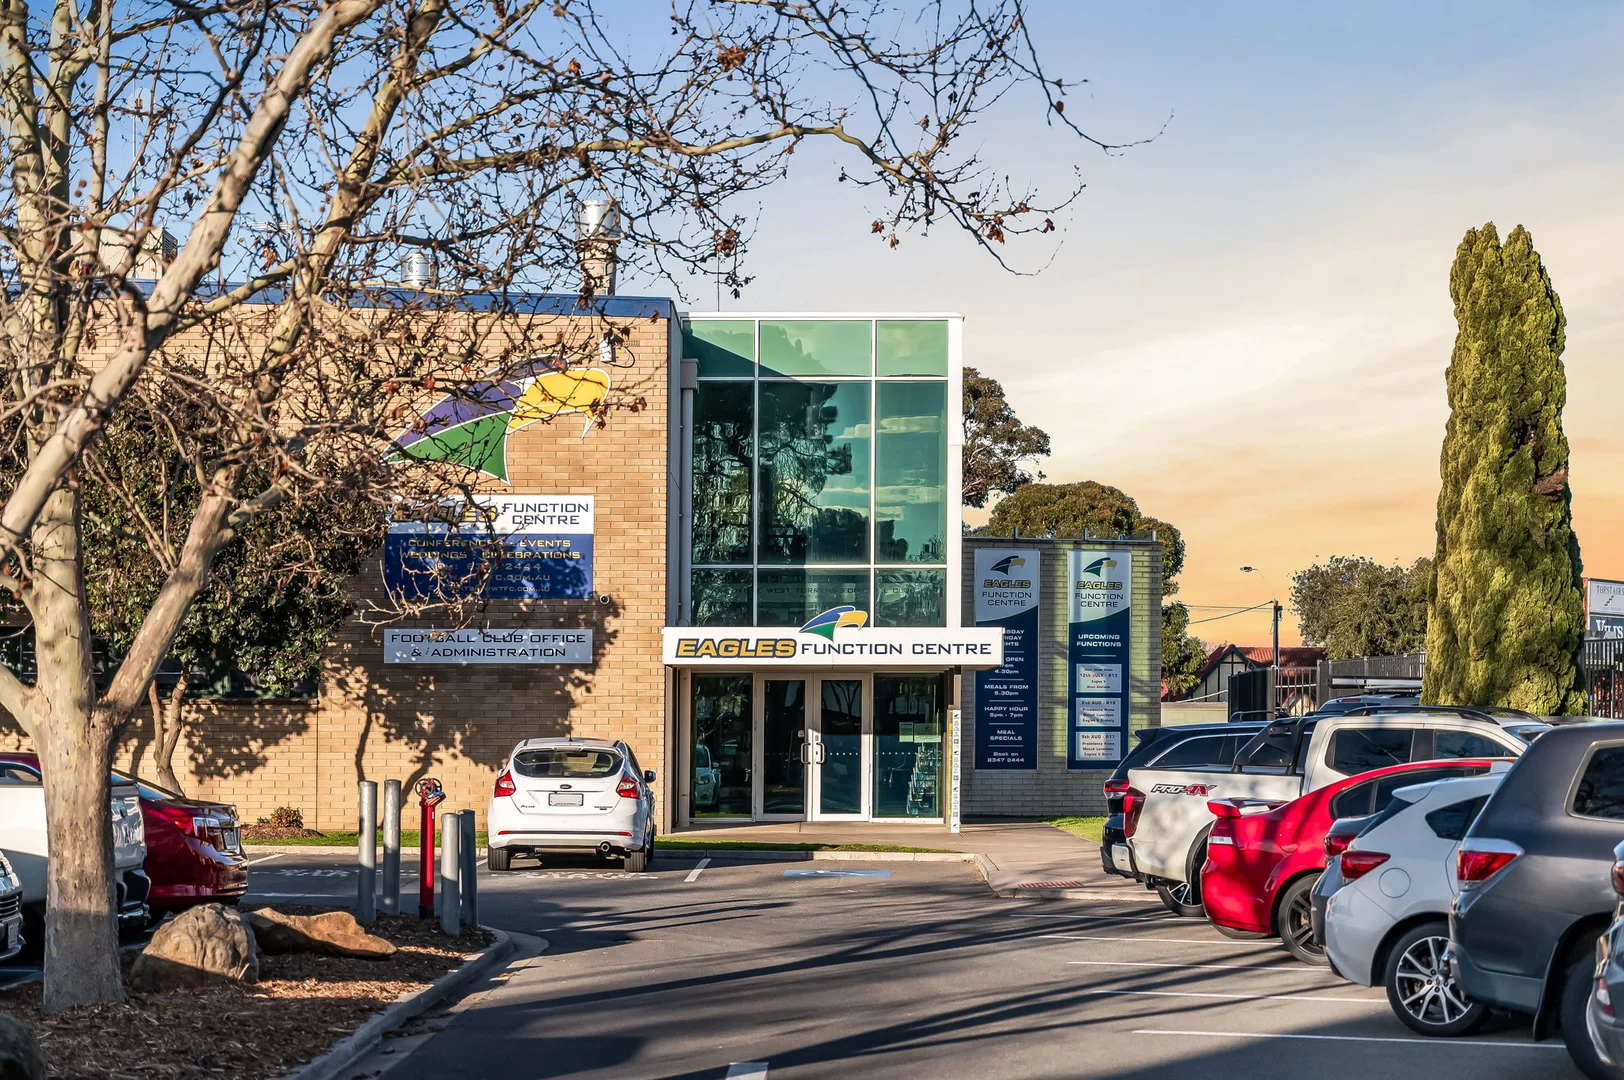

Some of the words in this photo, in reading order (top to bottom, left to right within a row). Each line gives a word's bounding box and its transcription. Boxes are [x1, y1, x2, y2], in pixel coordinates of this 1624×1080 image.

[503, 503, 588, 512] FUNCTION
[512, 515, 580, 524] CENTRE
[520, 539, 571, 547] EVENTS
[482, 551, 580, 559] CEEBRATIONS
[983, 579, 1031, 588] EAGLES
[1076, 581, 1123, 590] EAGLES
[482, 634, 523, 642] CLUB
[530, 634, 586, 642] OFFICE
[411, 648, 422, 656] &
[431, 648, 566, 656] ADMINISTRATION
[676, 638, 797, 658] EAGLES
[801, 643, 902, 655] FUNCTION
[912, 643, 992, 655] CENTRE
[1150, 783, 1217, 796] PRO-4X
